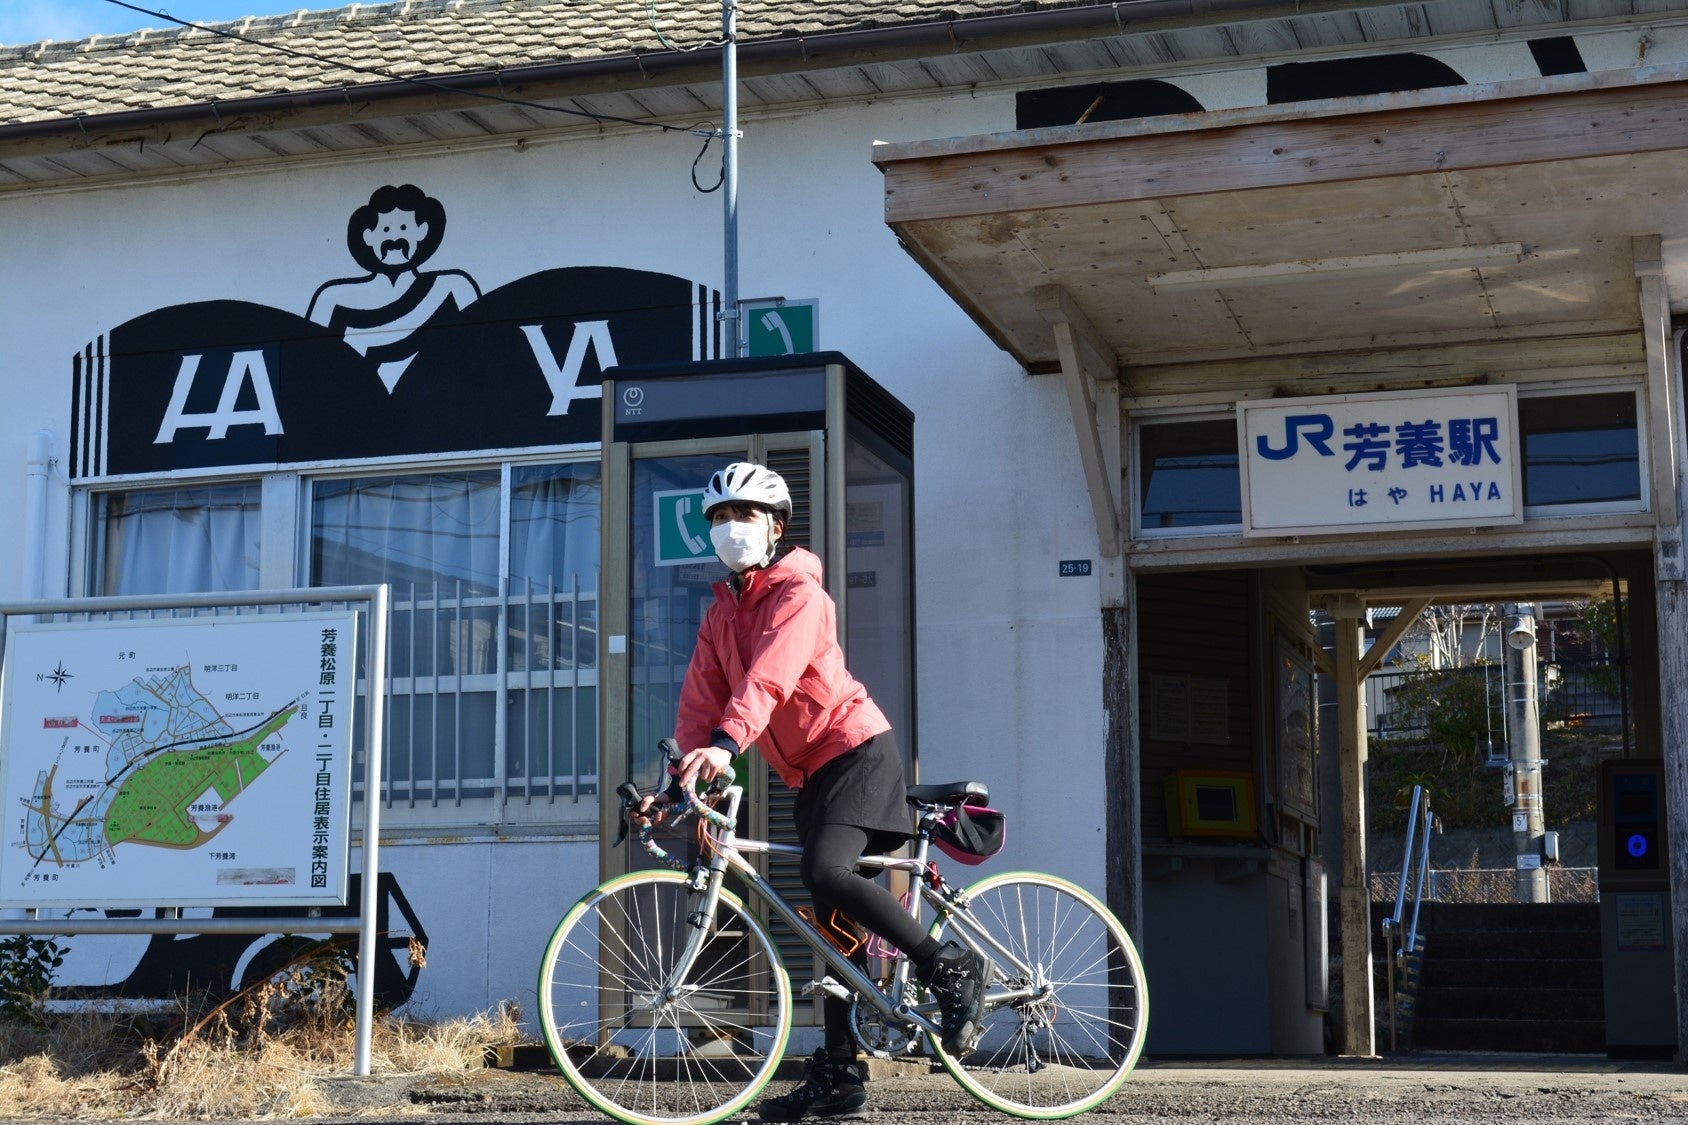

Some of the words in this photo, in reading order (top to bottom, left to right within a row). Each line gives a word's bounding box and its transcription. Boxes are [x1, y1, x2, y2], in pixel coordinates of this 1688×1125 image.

[624, 407, 642, 416] NTT
[1430, 481, 1502, 503] HAYA
[36, 673, 44, 681] N
